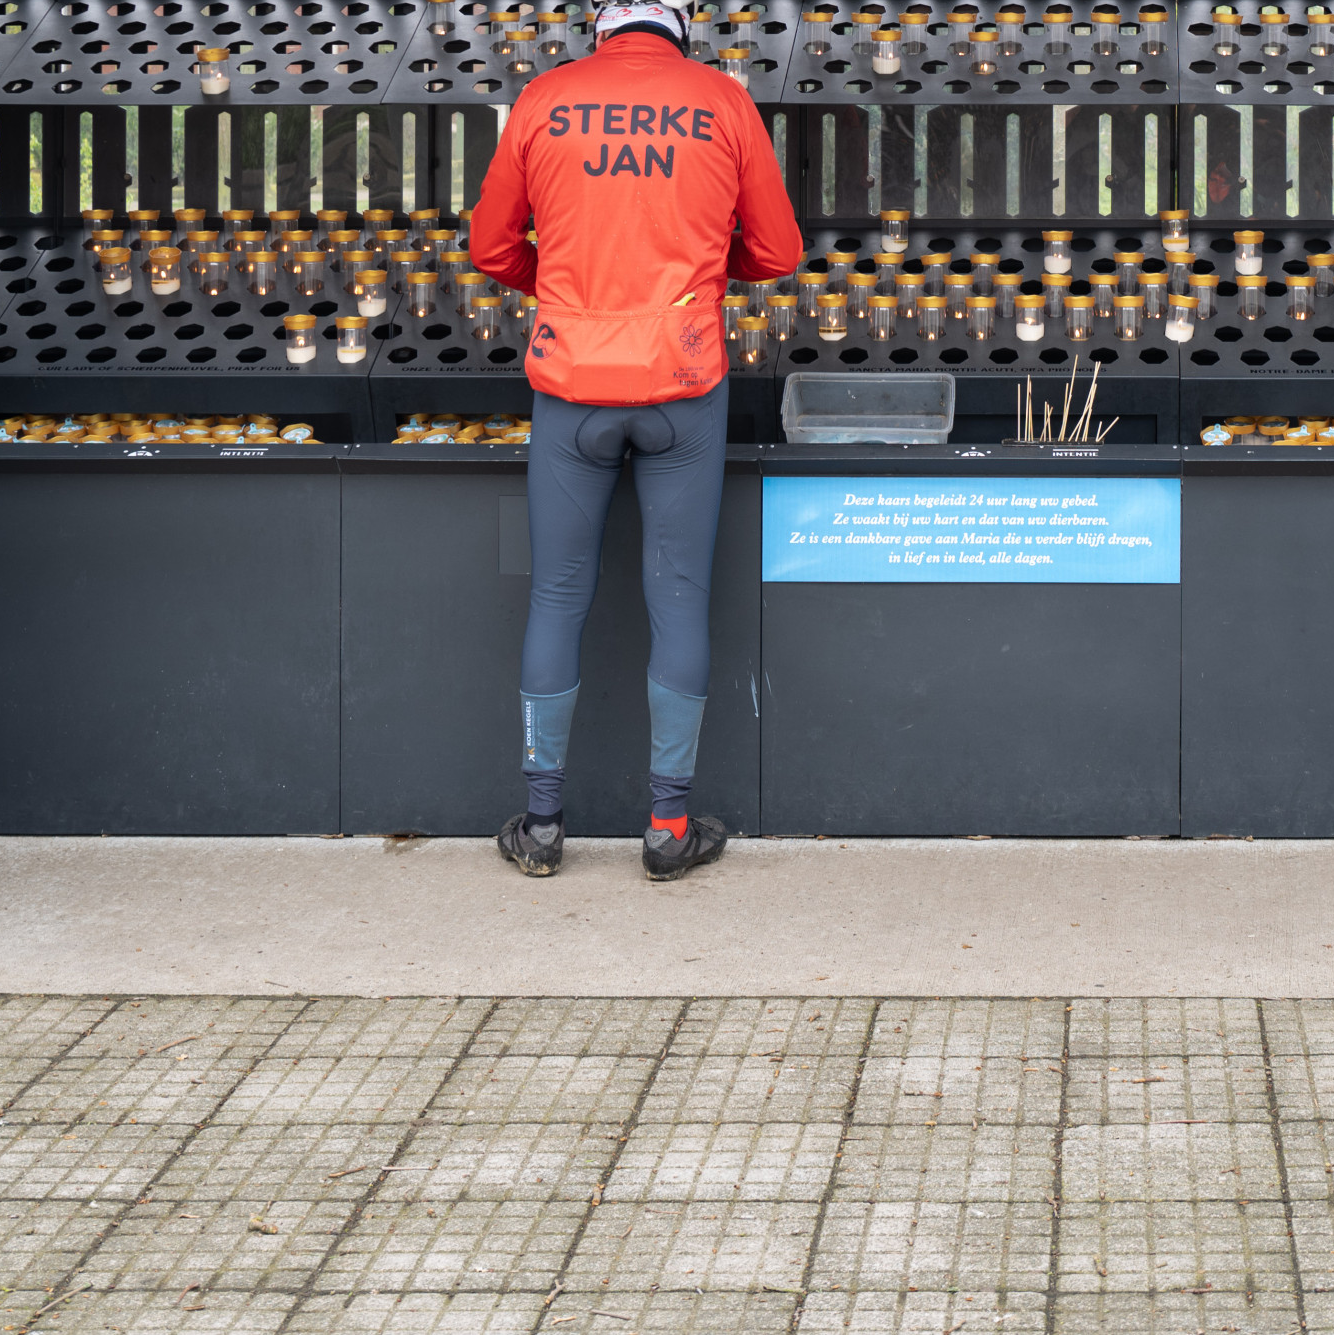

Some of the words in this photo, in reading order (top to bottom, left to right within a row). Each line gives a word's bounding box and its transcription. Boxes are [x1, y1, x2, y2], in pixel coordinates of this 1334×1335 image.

[549, 103, 715, 142] STERKE
[583, 143, 674, 179] JAN
[843, 494, 874, 505] Deze
[877, 494, 911, 506] kaars
[914, 494, 966, 508] begeleidt
[969, 494, 984, 506] 24
[987, 498, 1008, 506] uur
[1011, 494, 1038, 508] lang
[1040, 498, 1060, 506] uw
[1061, 495, 1098, 509] gebed.
[833, 513, 849, 524] Ze
[852, 513, 890, 525] waakt
[893, 513, 909, 527] bij
[912, 516, 931, 525] uw
[934, 513, 959, 525] hart
[962, 517, 976, 525] en
[979, 513, 999, 525] dat
[1002, 517, 1024, 525] van
[1028, 517, 1046, 525] uw
[1049, 514, 1109, 525] dierbaren.
[790, 532, 806, 543] Ze
[809, 532, 819, 543] is
[845, 532, 901, 544] dankbare
[904, 536, 932, 546] gave
[935, 536, 958, 544] aan
[961, 532, 1000, 544] Maria
[1003, 533, 1021, 544] die
[1024, 536, 1032, 544] u
[1035, 533, 1074, 544] verder
[1076, 533, 1105, 547] blijft
[1108, 533, 1152, 547] dragen,
[889, 551, 900, 563] in
[904, 551, 925, 565] lief
[926, 555, 940, 563] en
[944, 551, 955, 563] in
[959, 551, 986, 565] leed,
[989, 552, 1012, 563] alle
[1014, 552, 1053, 566] dagen.
